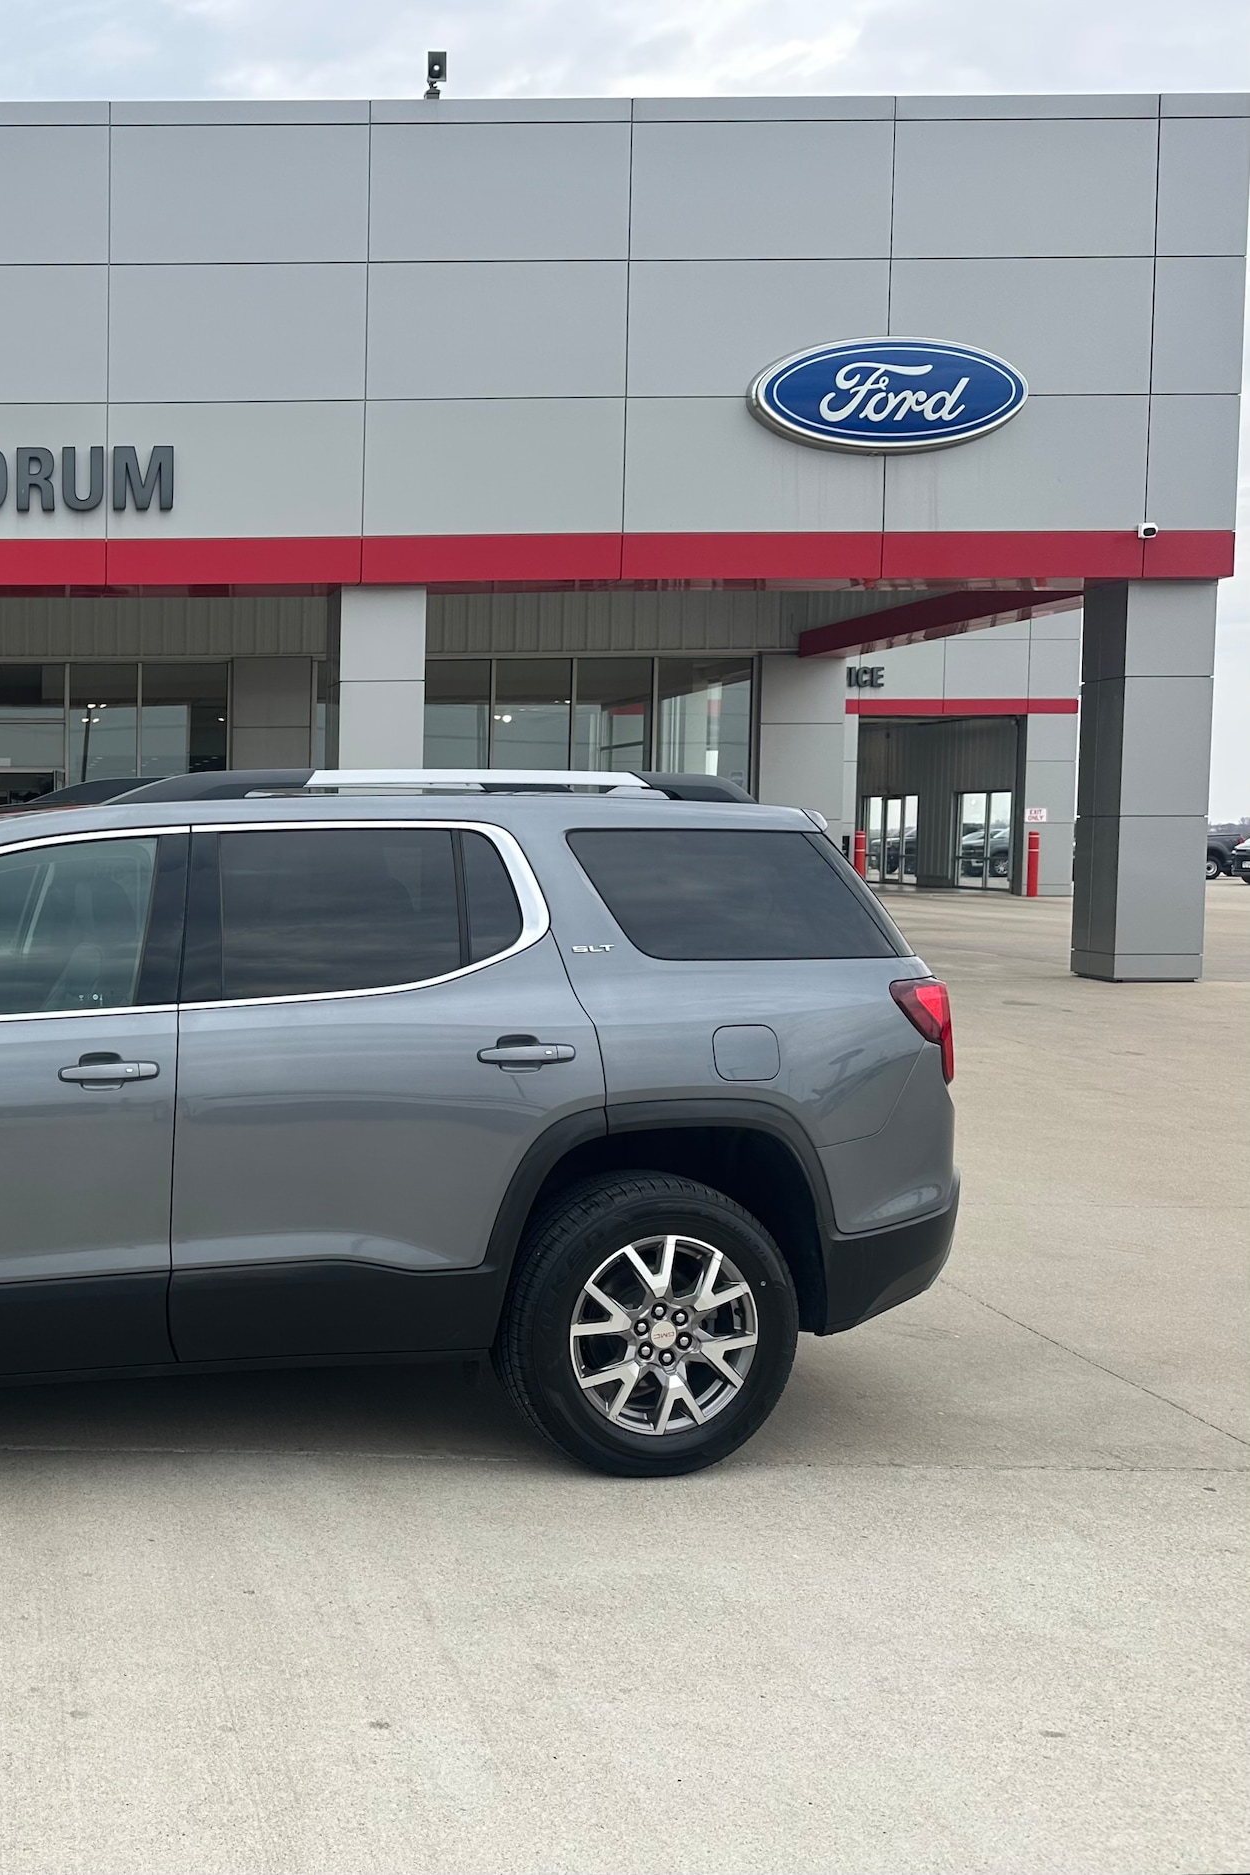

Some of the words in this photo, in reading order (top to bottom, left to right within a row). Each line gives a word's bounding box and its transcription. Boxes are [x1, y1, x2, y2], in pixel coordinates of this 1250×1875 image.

[819, 361, 970, 422] Ford
[572, 944, 615, 953] SLT
[653, 1331, 674, 1340] GMC
